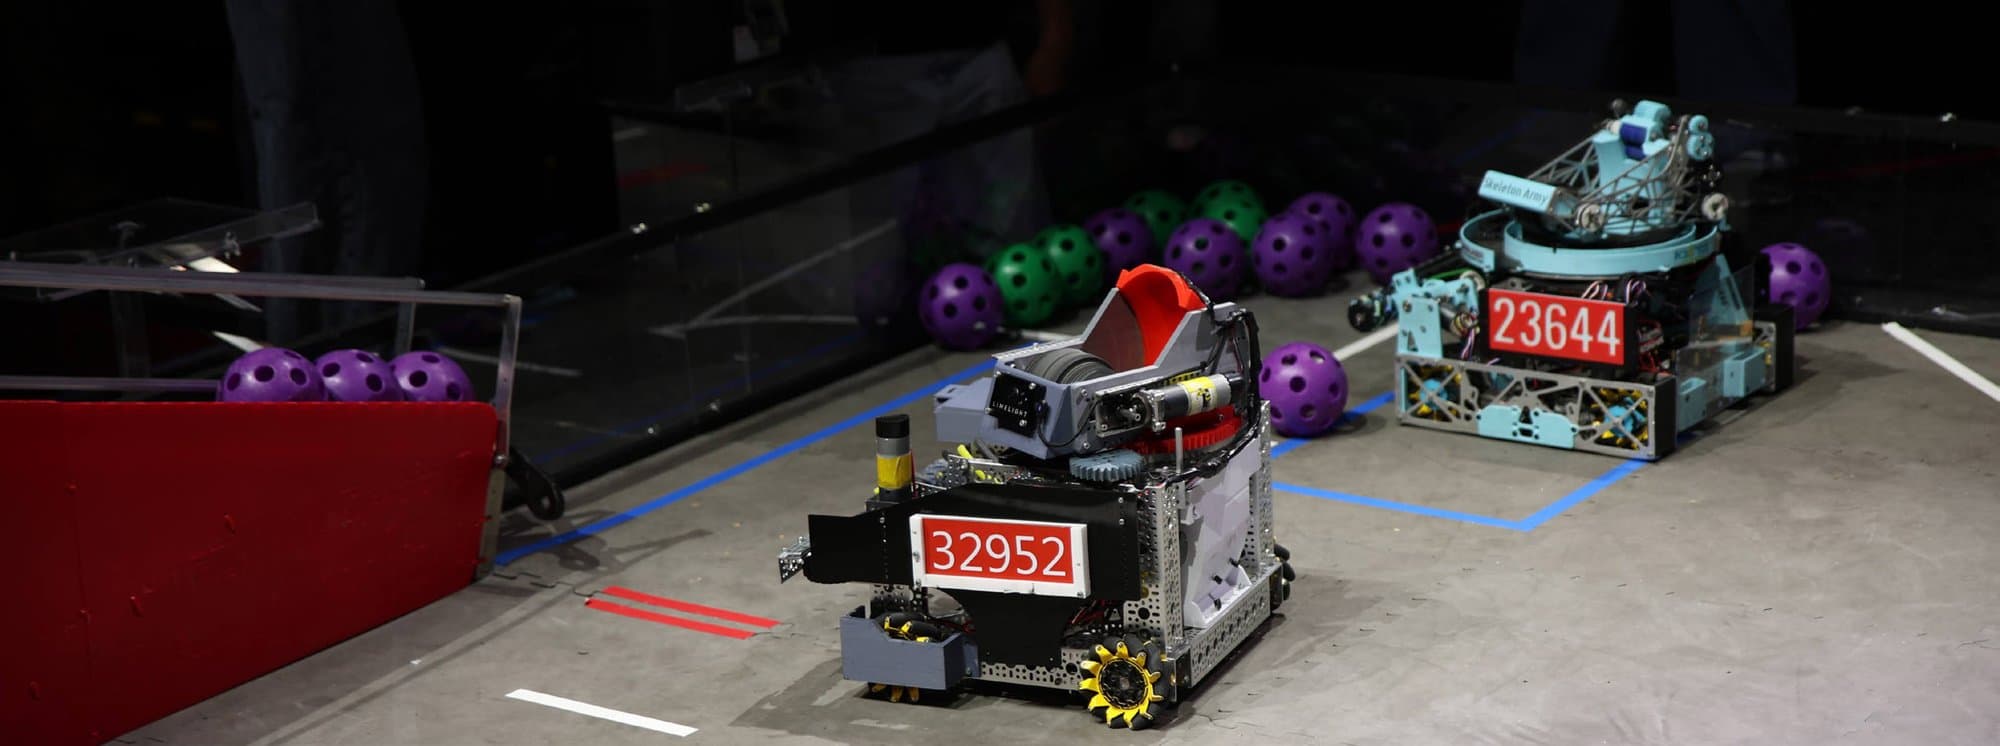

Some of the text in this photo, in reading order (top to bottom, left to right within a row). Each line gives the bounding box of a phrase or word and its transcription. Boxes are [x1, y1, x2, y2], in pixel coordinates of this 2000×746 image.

[1484, 178, 1549, 206] Skeleton Army
[1494, 297, 1620, 356] 23644
[992, 400, 1028, 418] LIMELIGHT
[932, 530, 1067, 577] 32952
